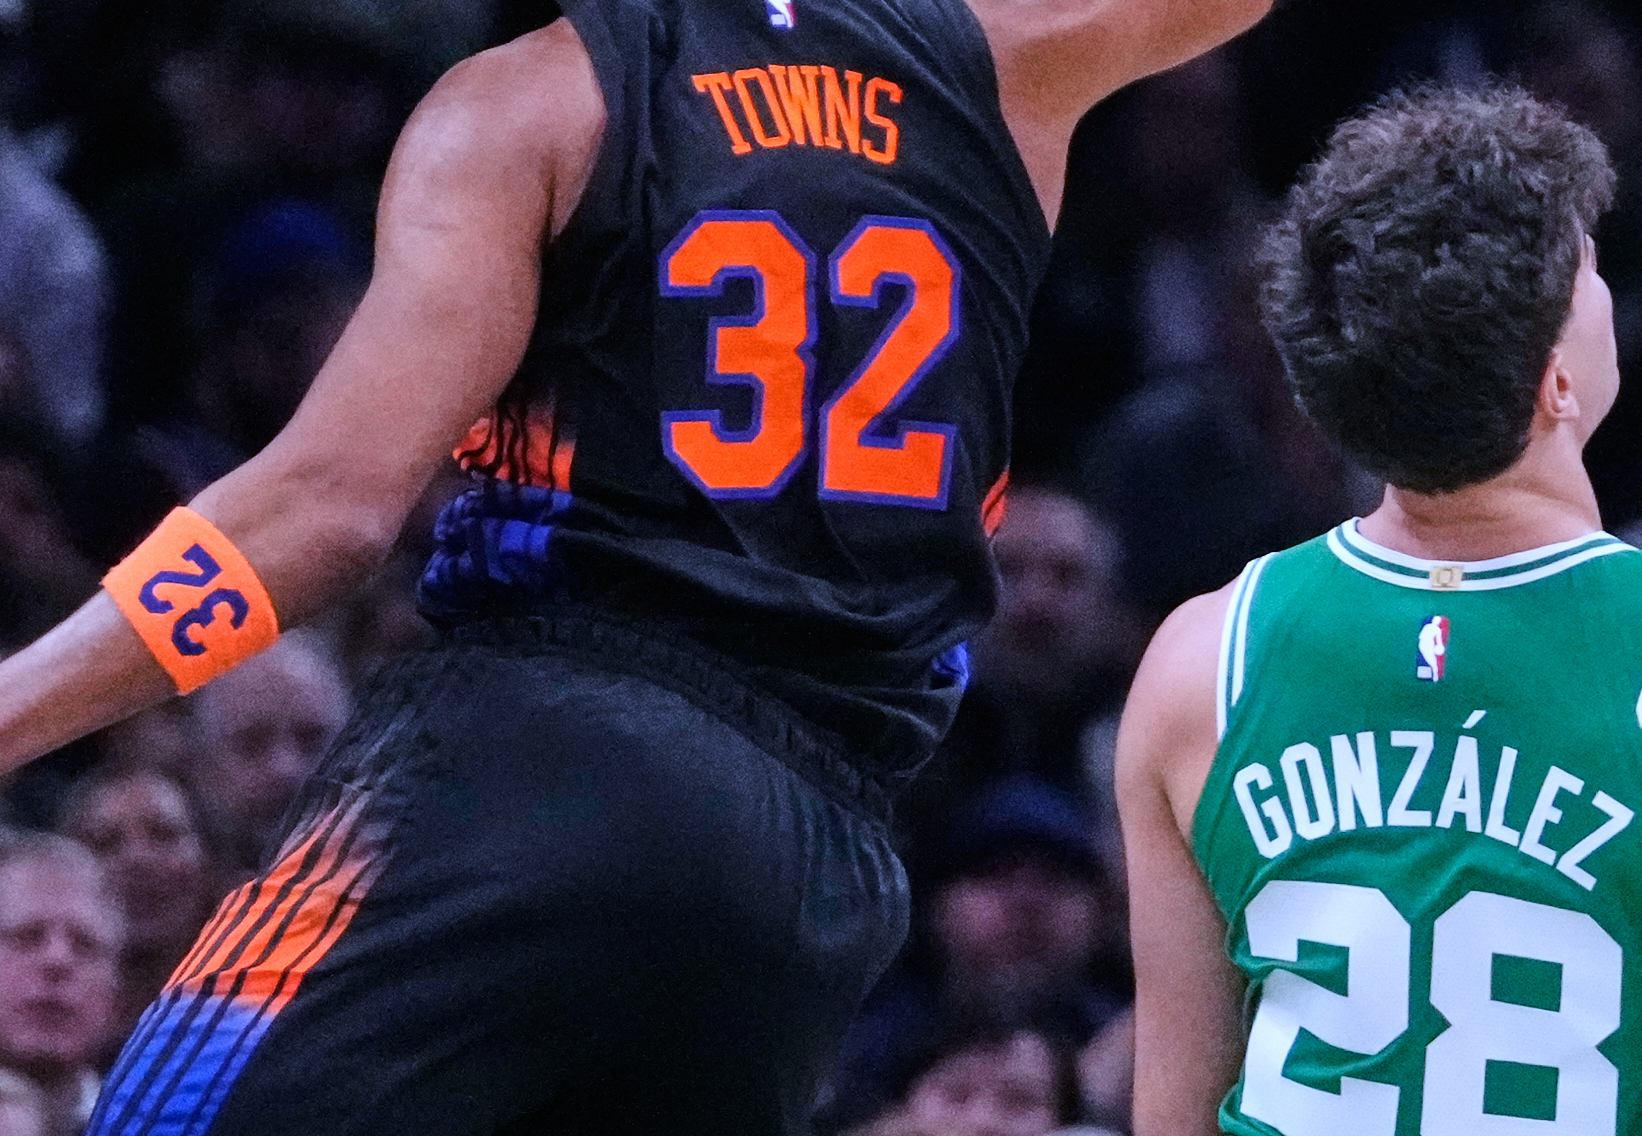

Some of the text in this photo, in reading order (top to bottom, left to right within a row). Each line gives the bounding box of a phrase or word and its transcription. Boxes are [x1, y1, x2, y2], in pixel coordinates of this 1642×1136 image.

[692, 64, 903, 164] TOWNS
[658, 209, 962, 511] 32
[138, 543, 249, 656] 32
[1232, 710, 1635, 892] GONZÁLEZ
[1240, 880, 1624, 1136] 28
